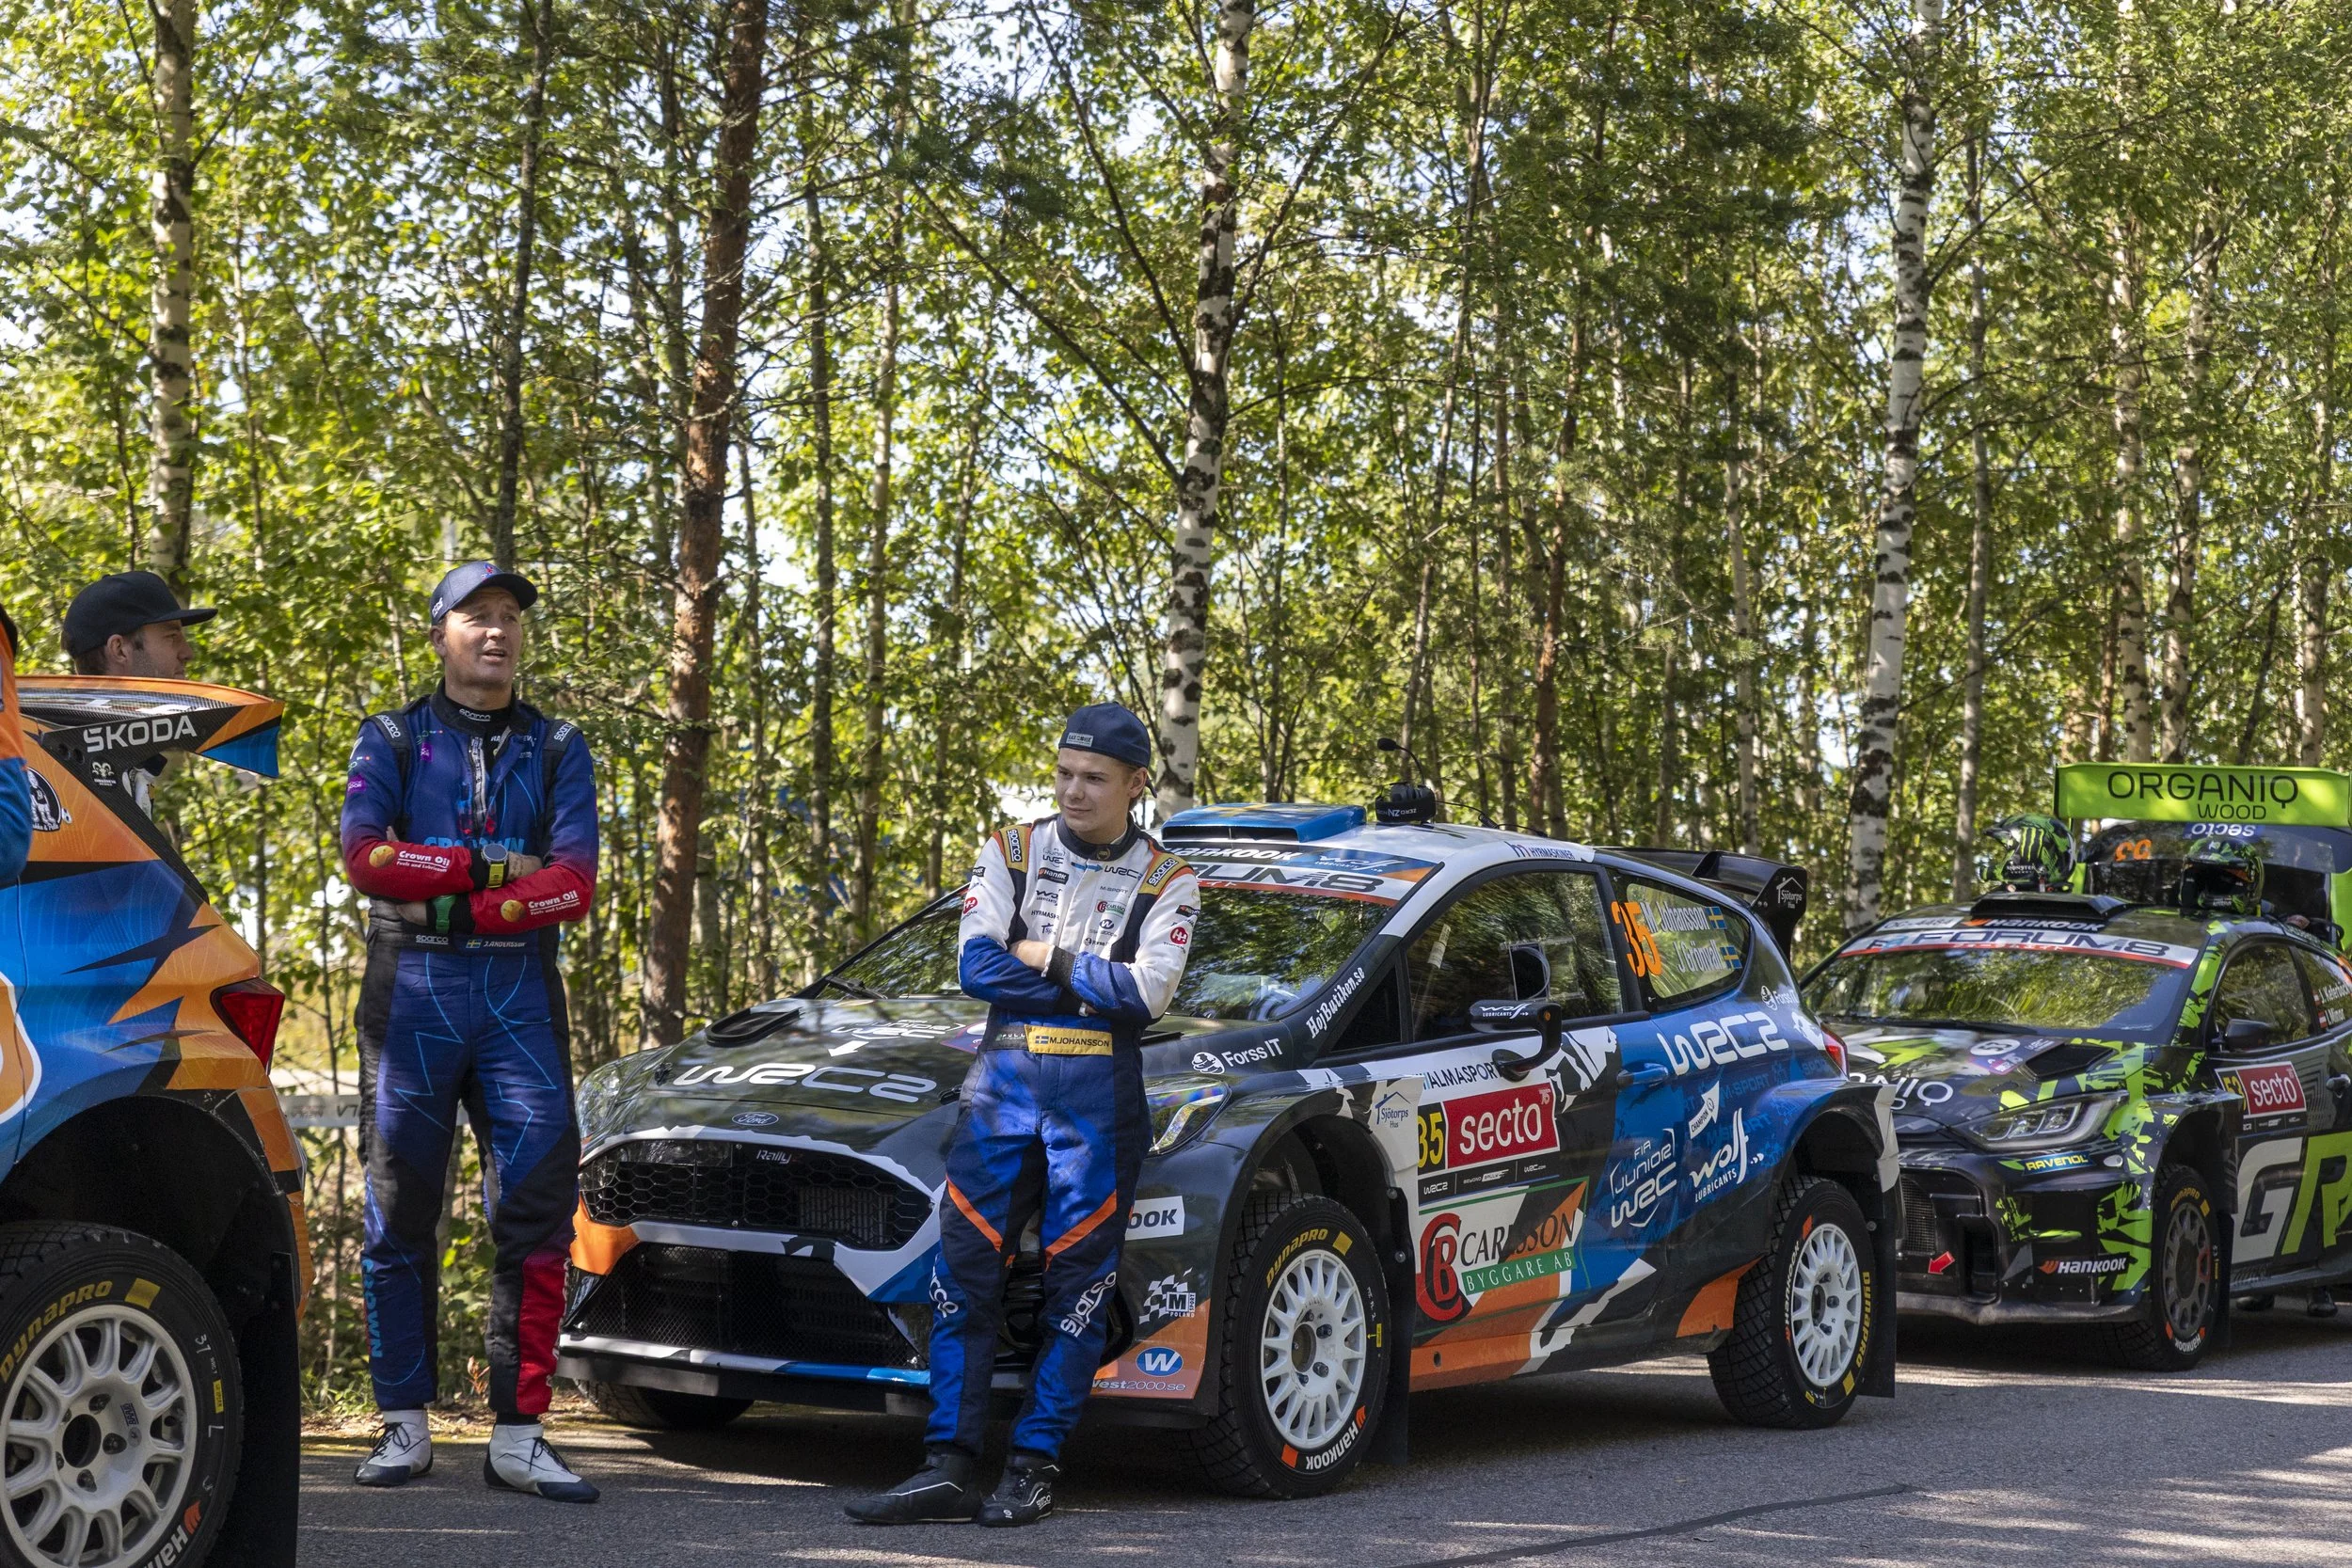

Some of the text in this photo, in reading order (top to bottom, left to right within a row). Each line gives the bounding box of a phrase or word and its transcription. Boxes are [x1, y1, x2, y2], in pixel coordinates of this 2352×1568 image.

[2107, 771, 2299, 810] ORGANIQ
[2198, 803, 2267, 821] WOOD
[399, 850, 451, 866] Crown Oil
[1007, 830, 1022, 863] sparco
[1148, 858, 1178, 886] sparco
[528, 890, 579, 909] Crown Oil
[416, 934, 449, 945] sparco
[1611, 900, 1663, 977] 35
[1912, 929, 2169, 957] FORUM8
[1049, 1037, 1110, 1047] M.JOHANSSON
[1221, 1037, 1283, 1068] Forss IT
[1657, 1011, 1789, 1076] WRC2
[672, 1063, 938, 1103] WRC2
[2249, 1075, 2298, 1106] secto
[1381, 1107, 1409, 1121] Sjötorps
[1390, 1119, 1399, 1129] Hus
[1459, 1098, 1542, 1155] secto
[1691, 1111, 1709, 1133] CHAMPION
[1418, 1112, 1445, 1168] 35
[1634, 1140, 1652, 1160] FIA
[1614, 1143, 1672, 1195] JUNIOR
[2026, 1154, 2088, 1171] RAVENOL
[1423, 1181, 1449, 1196] WRC2
[1611, 1162, 1677, 1228] WRC
[1694, 1168, 1738, 1203] LUBRICANTS
[1467, 1251, 1573, 1291] BYGGARE AB
[1060, 1271, 1117, 1338] sparco
[1144, 1353, 1180, 1372] W
